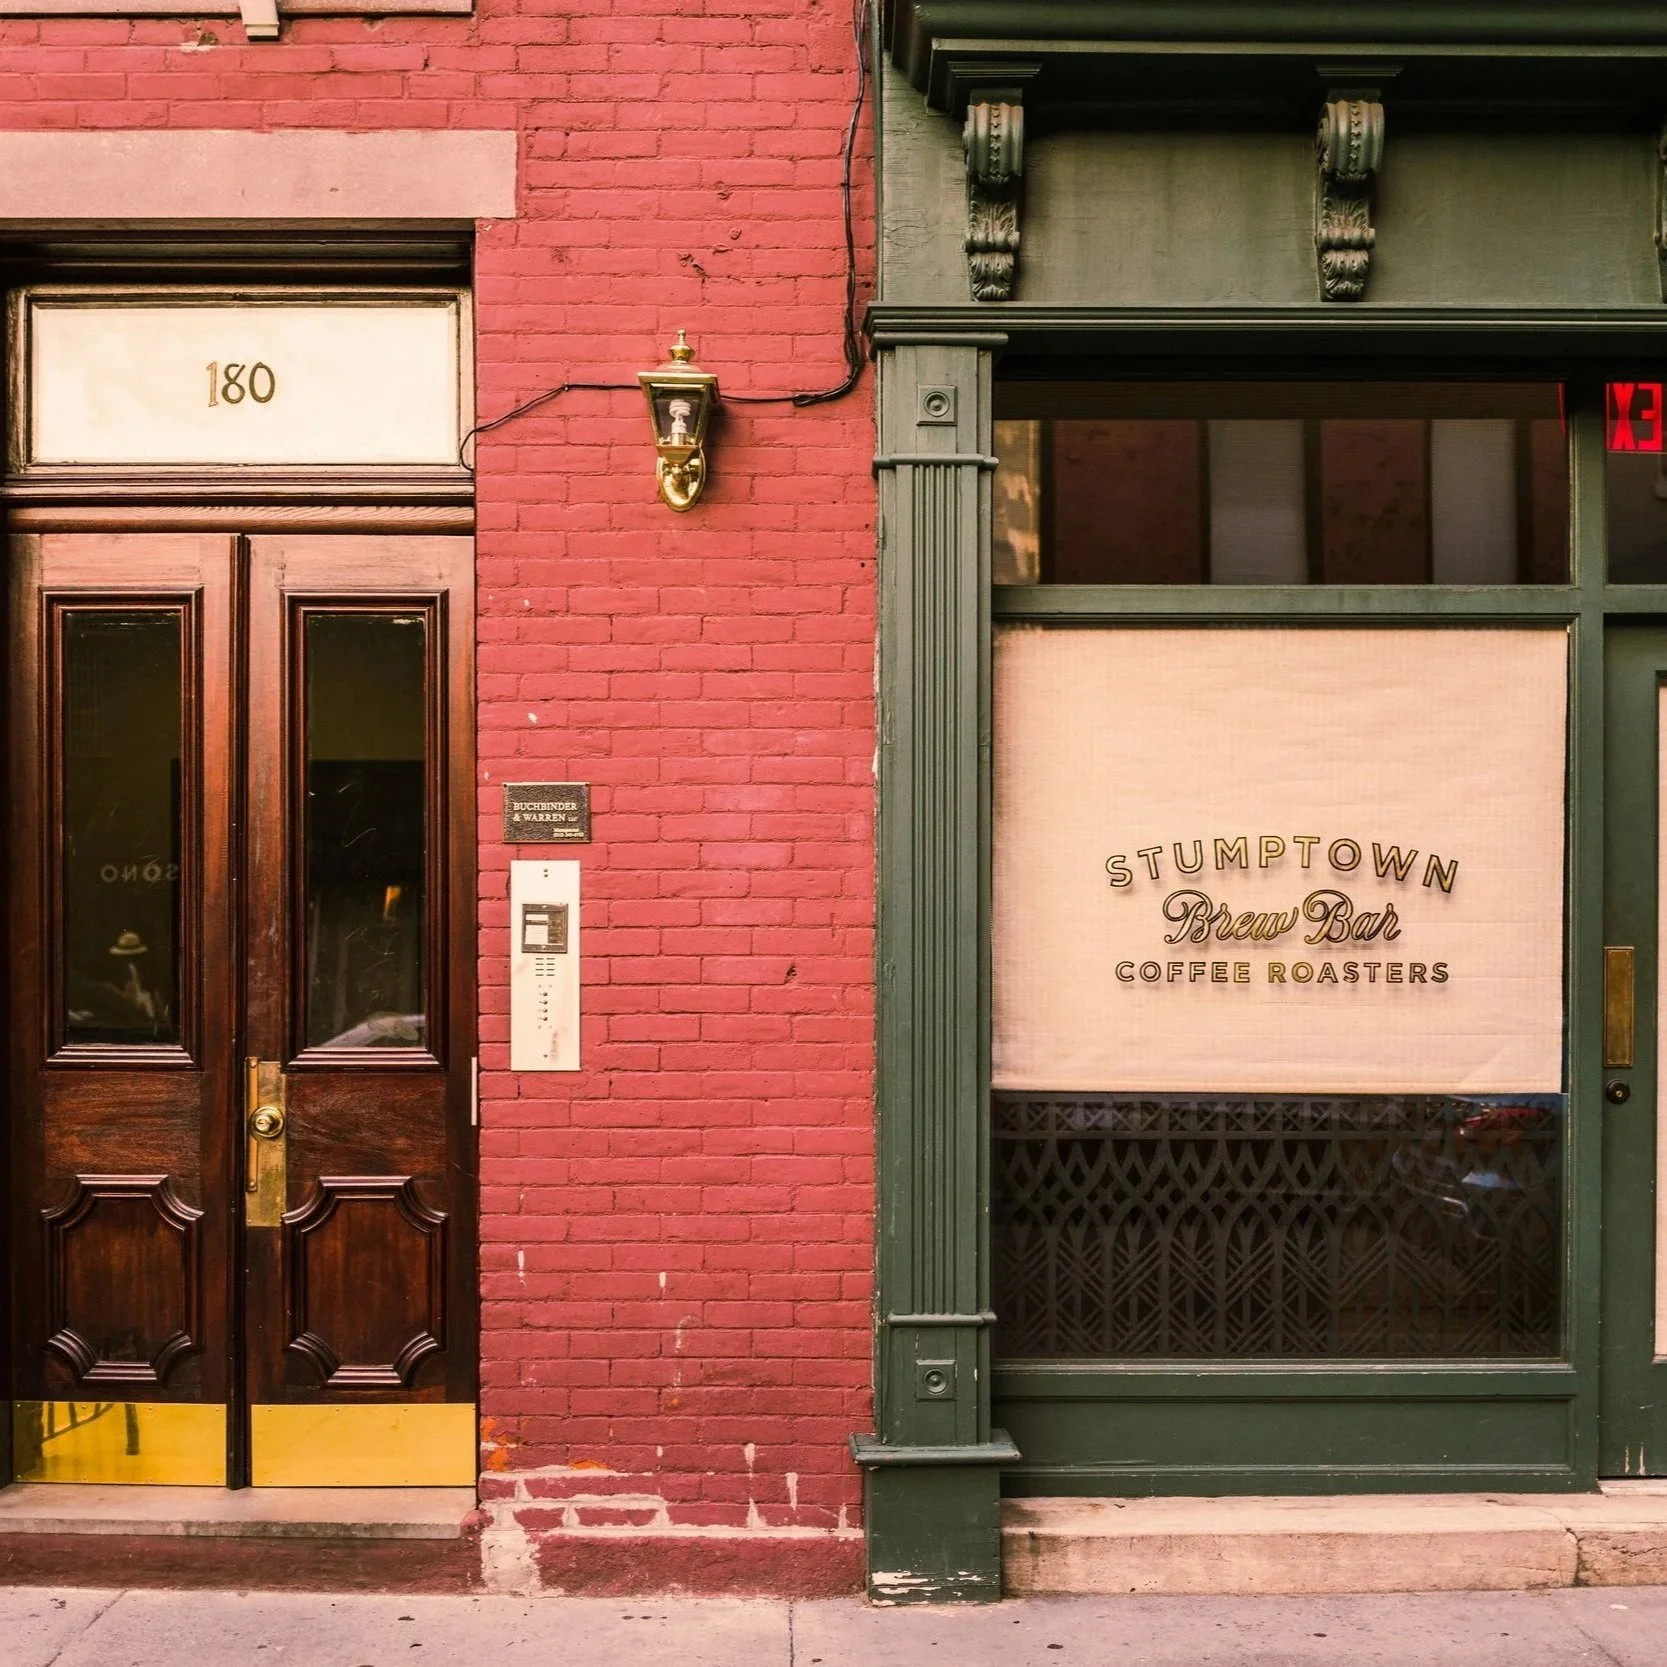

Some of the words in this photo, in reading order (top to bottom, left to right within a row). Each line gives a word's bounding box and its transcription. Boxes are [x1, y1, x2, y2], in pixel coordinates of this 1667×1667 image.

[206, 361, 276, 407] 180
[513, 802, 577, 811] BUCHBINDER
[513, 813, 521, 822] &
[522, 813, 566, 822] WARREN
[1105, 835, 1459, 894] STUMPTOWN
[1162, 889, 1299, 945] Brew
[1302, 889, 1402, 945] Bar
[1115, 960, 1251, 983] COFFEE
[1268, 961, 1449, 984] ROASTERS
